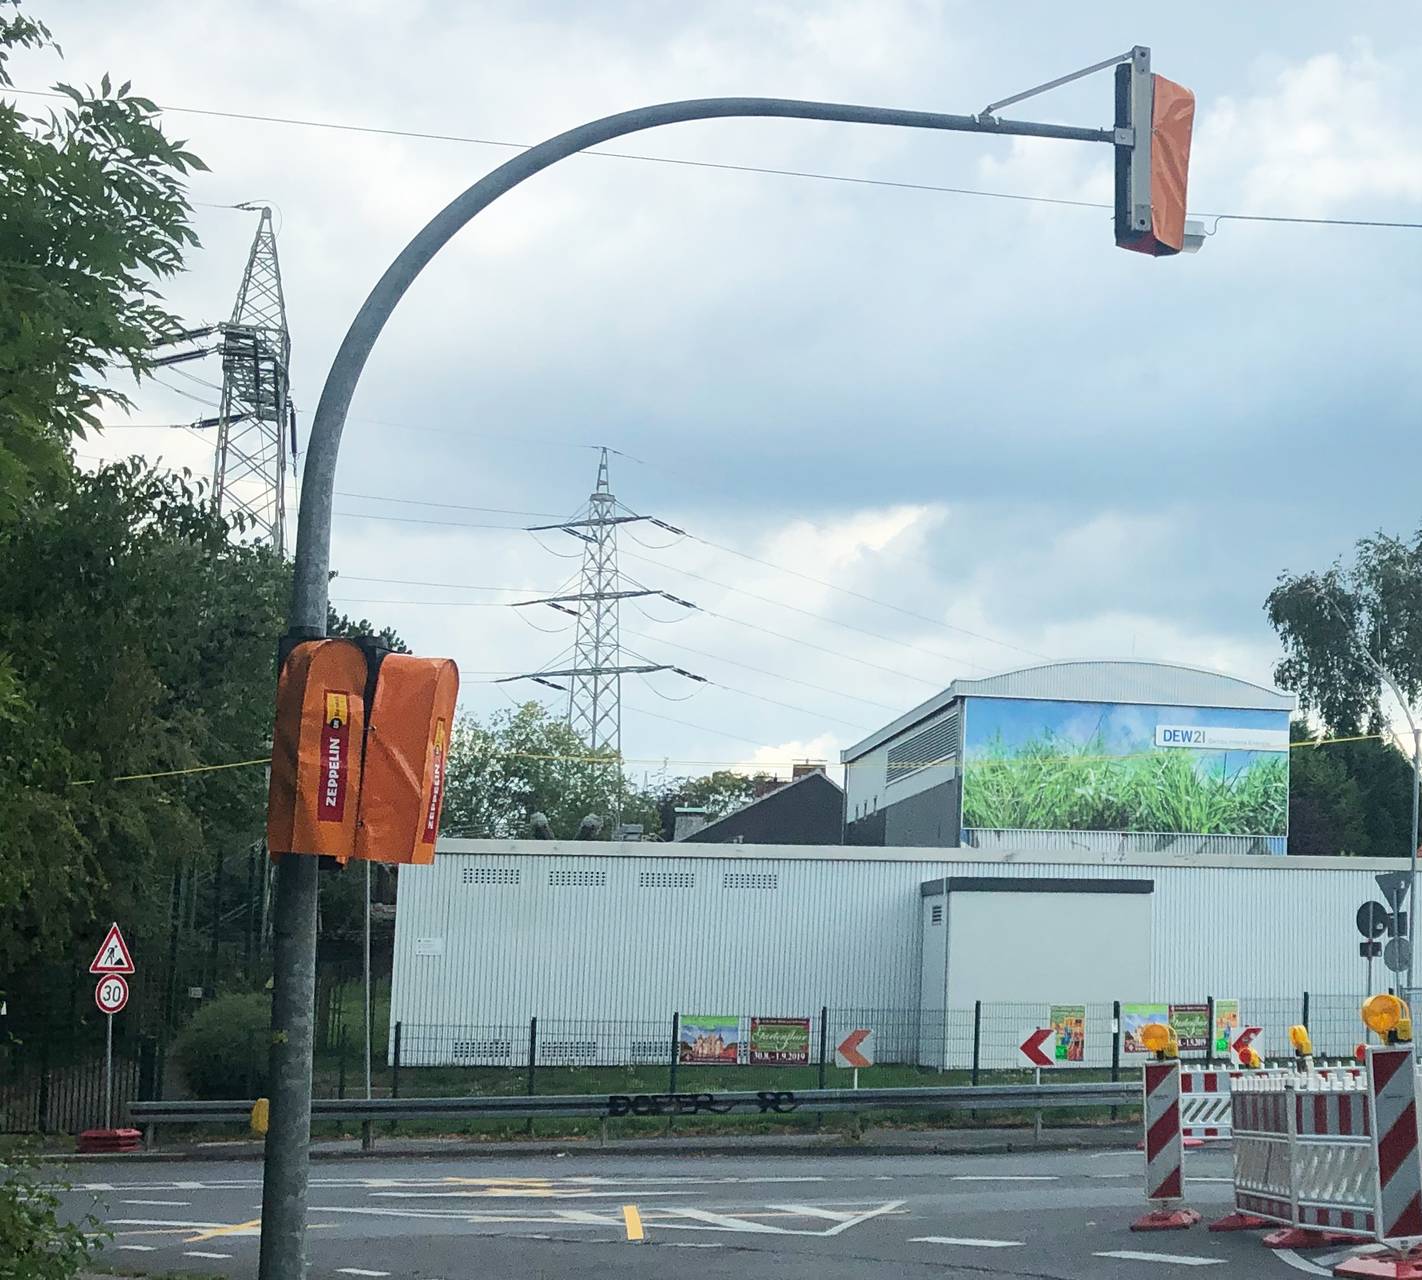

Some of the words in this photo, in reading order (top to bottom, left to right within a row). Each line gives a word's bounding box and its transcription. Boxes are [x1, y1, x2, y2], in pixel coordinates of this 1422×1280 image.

[326, 738, 340, 807] ZEPPELIN
[427, 763, 441, 830] ZEPPELIN
[103, 985, 121, 1002] 30
